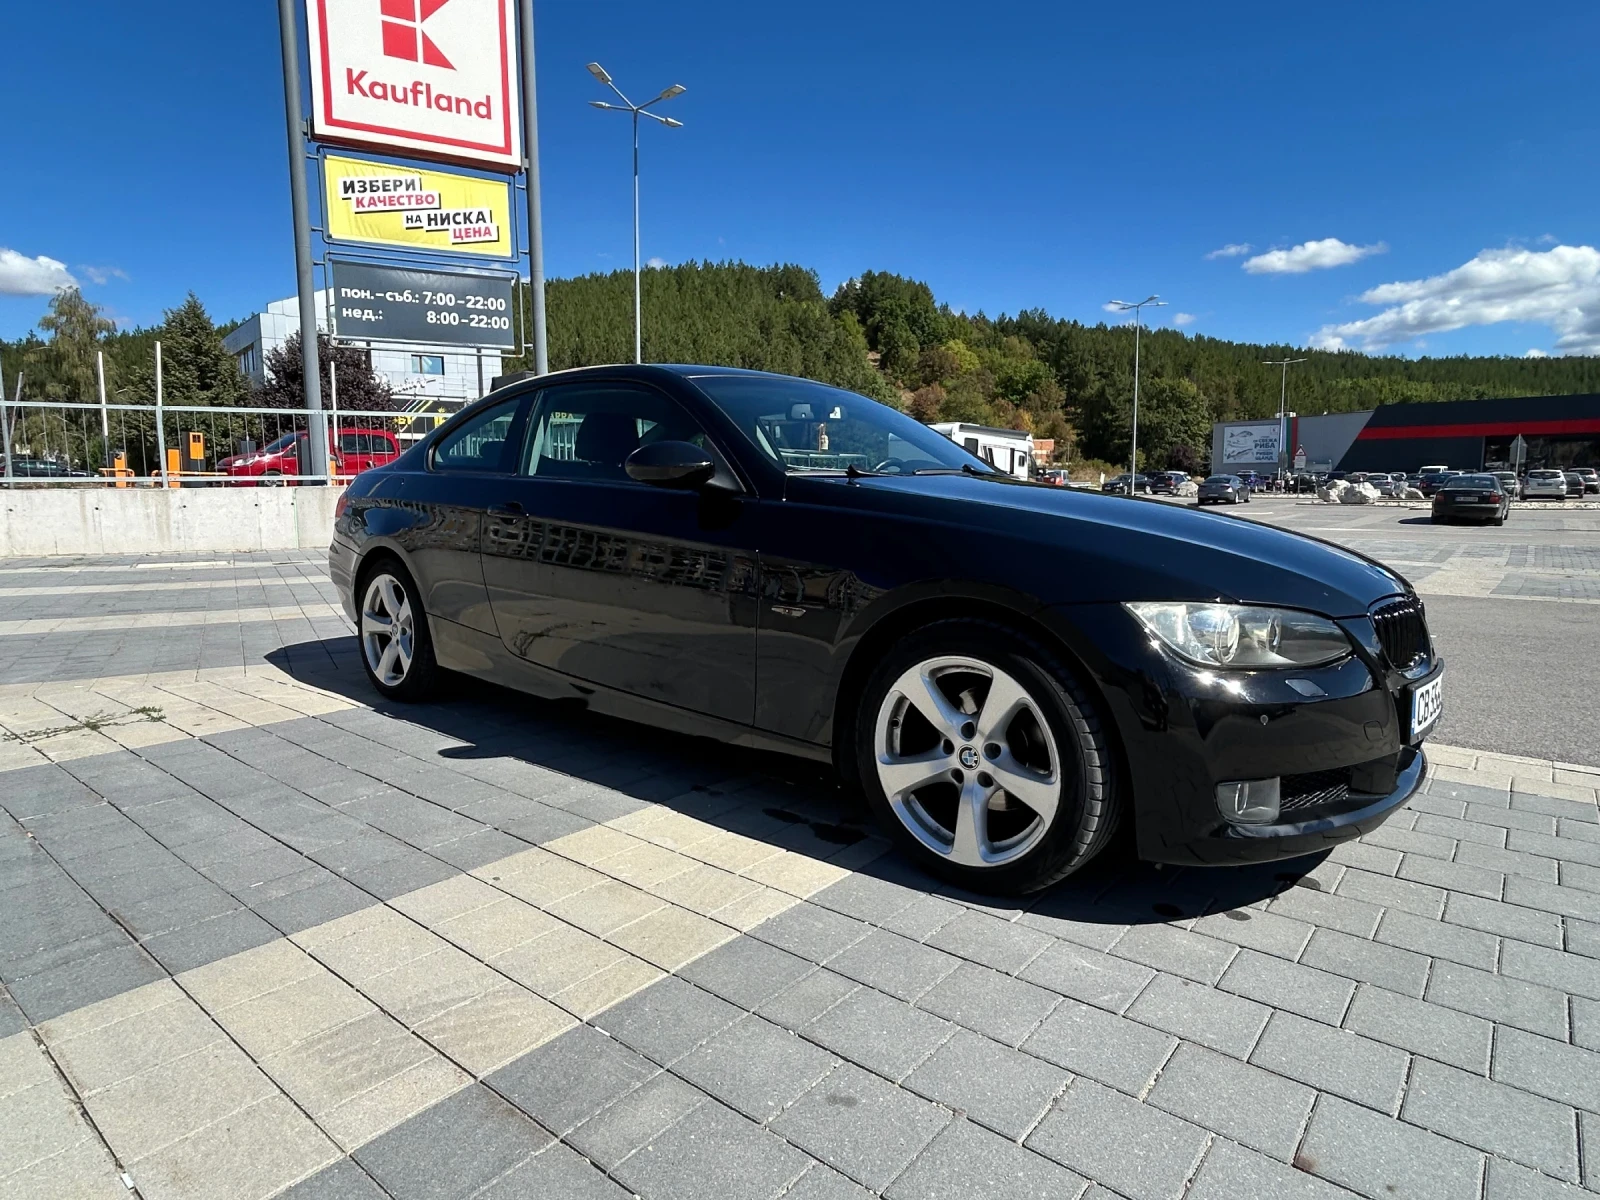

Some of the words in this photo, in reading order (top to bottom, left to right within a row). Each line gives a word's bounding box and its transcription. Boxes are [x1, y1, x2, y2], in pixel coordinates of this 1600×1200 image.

[346, 67, 492, 120] Kaufland
[342, 178, 416, 195] ИЗБЕРИ
[355, 193, 436, 209] КАЧЕСТВО
[405, 214, 423, 225] НА
[427, 211, 487, 226] НИСКА
[453, 226, 492, 241] ЦЕНА
[342, 307, 384, 322] нед.:
